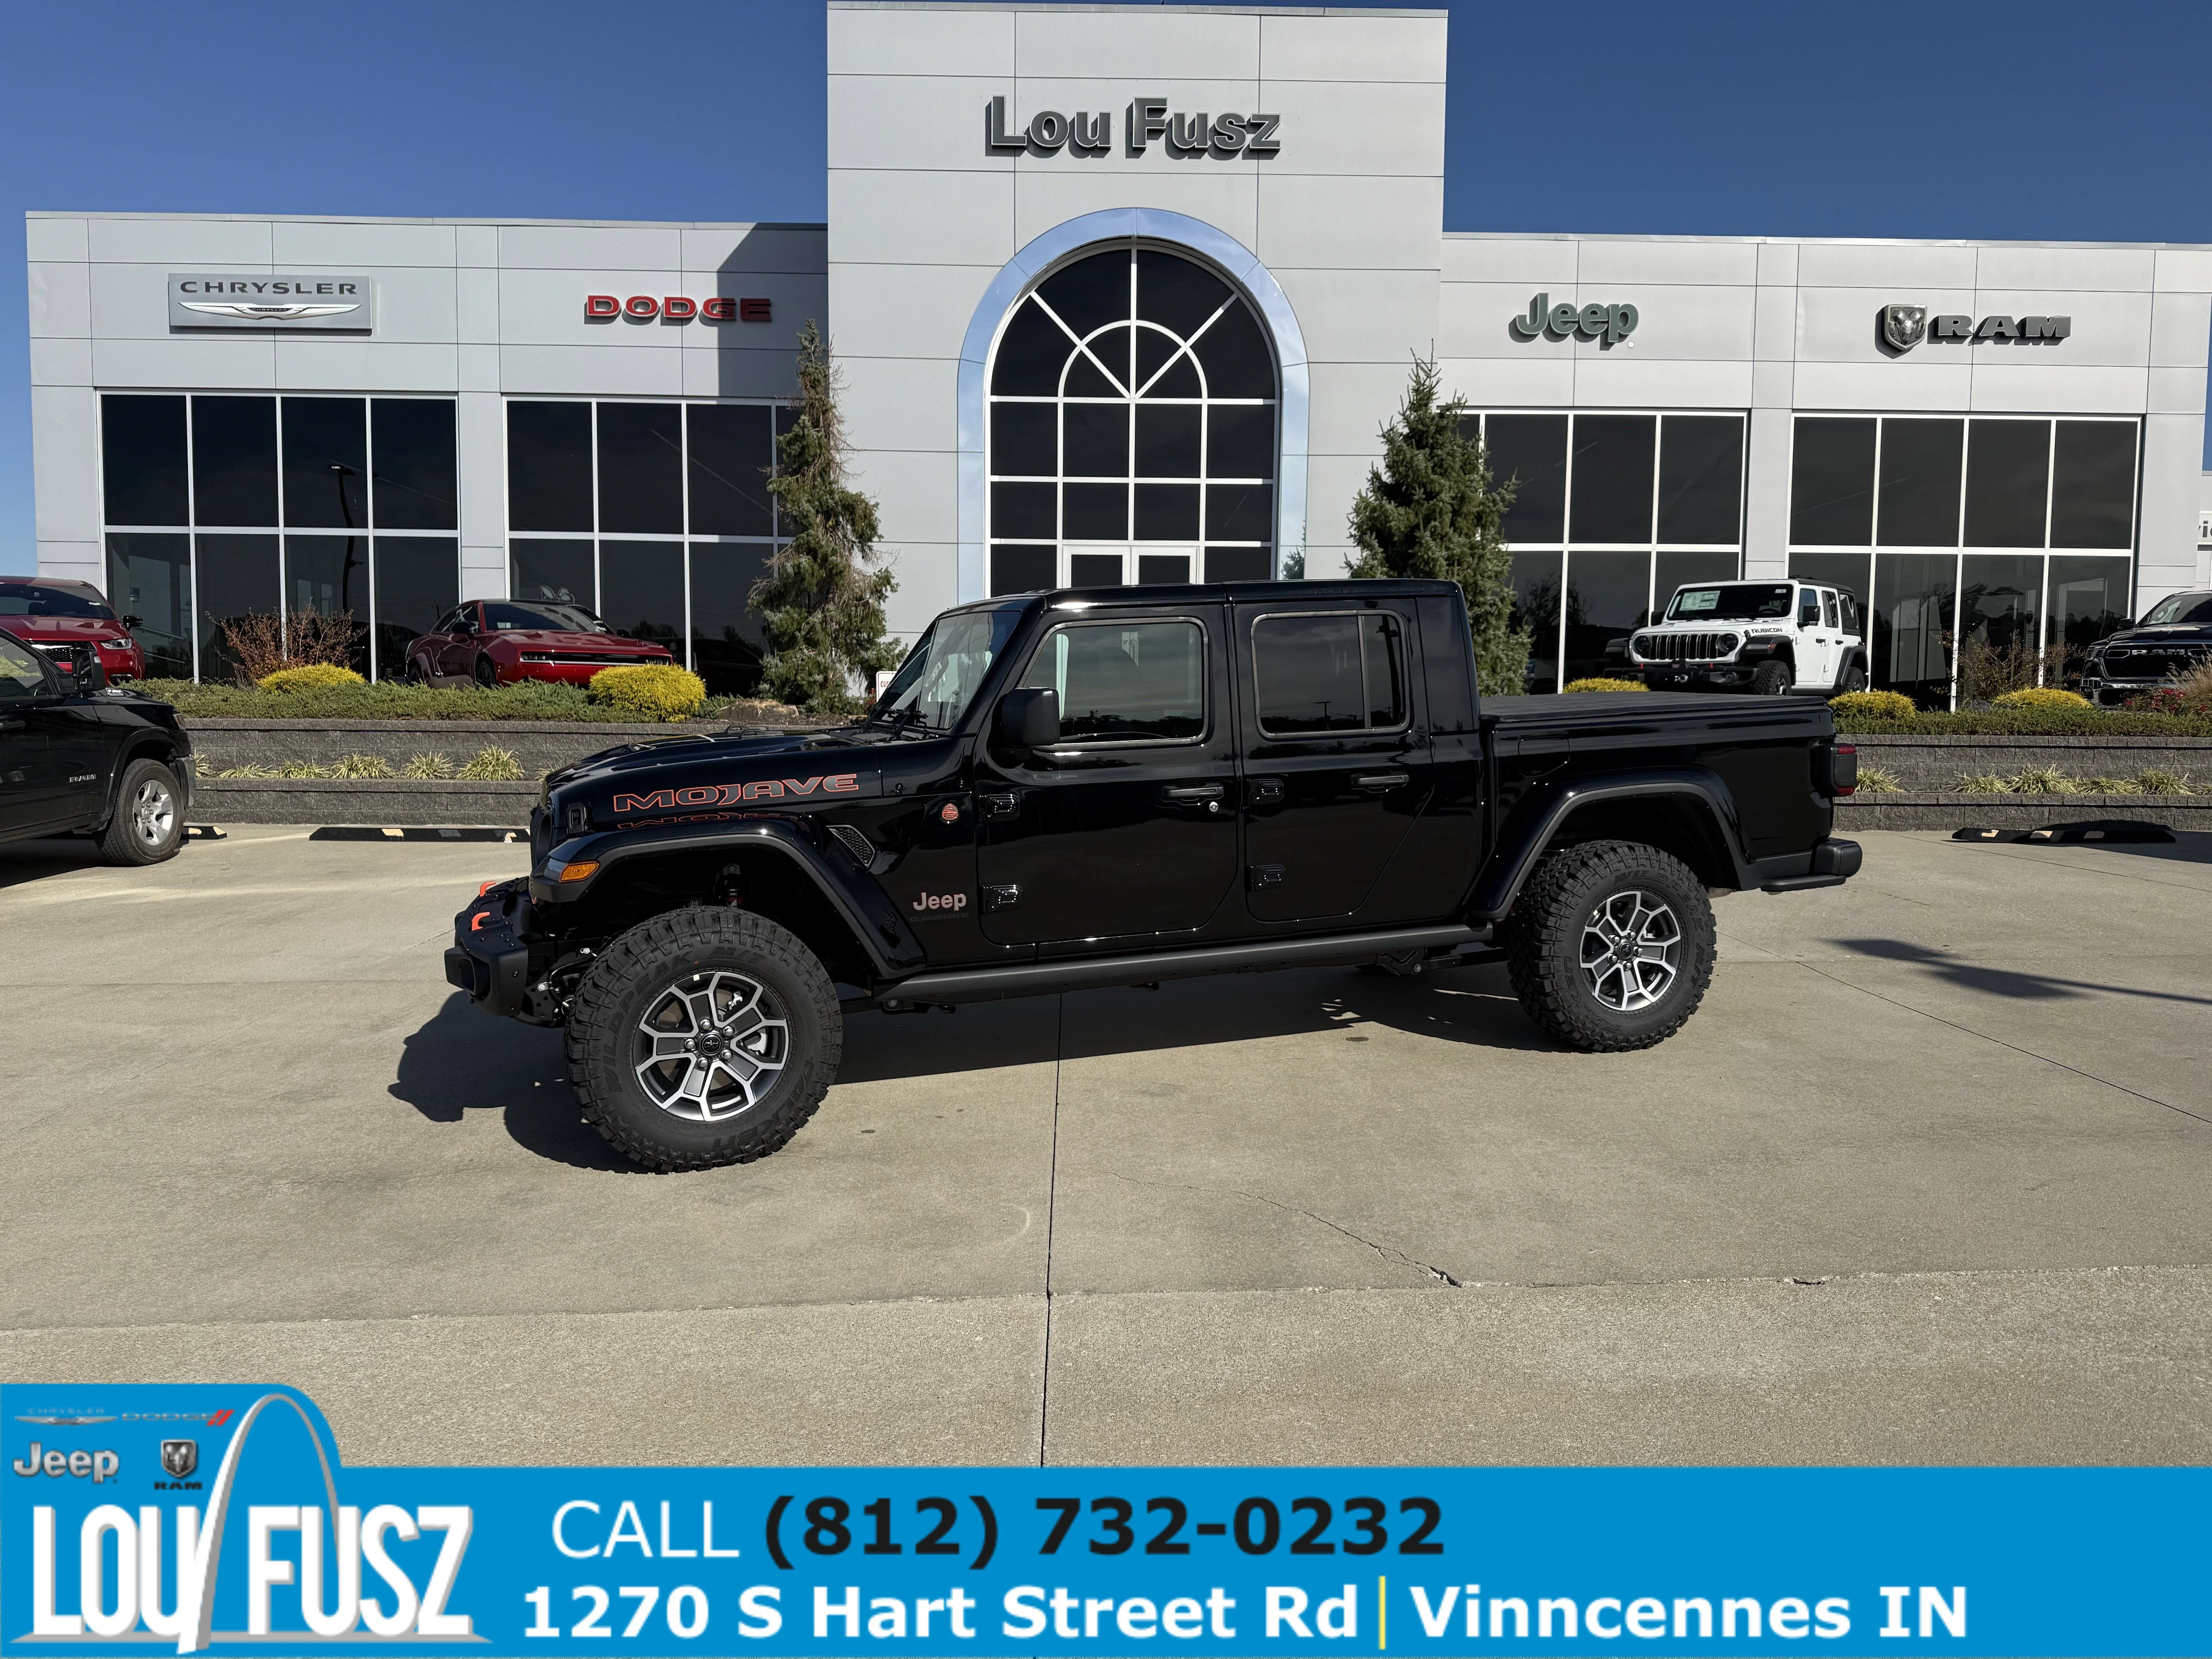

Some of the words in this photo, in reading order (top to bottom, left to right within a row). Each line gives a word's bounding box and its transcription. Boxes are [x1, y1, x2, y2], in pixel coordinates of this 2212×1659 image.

[991, 94, 1112, 149] Lou
[1132, 96, 1282, 153] Fusz
[180, 281, 358, 295] CHRYSLER
[587, 295, 772, 322] DODGE
[1516, 292, 1639, 342] Jeep
[1938, 315, 2071, 337] RAM
[69, 774, 96, 783] RAM
[613, 773, 859, 812] MOJAVE
[912, 892, 967, 911] Jeep
[1613, 869, 1704, 931] WILDPEAK
[909, 912, 960, 922] GLADIATOR
[603, 951, 694, 1093] WILDPEAK
